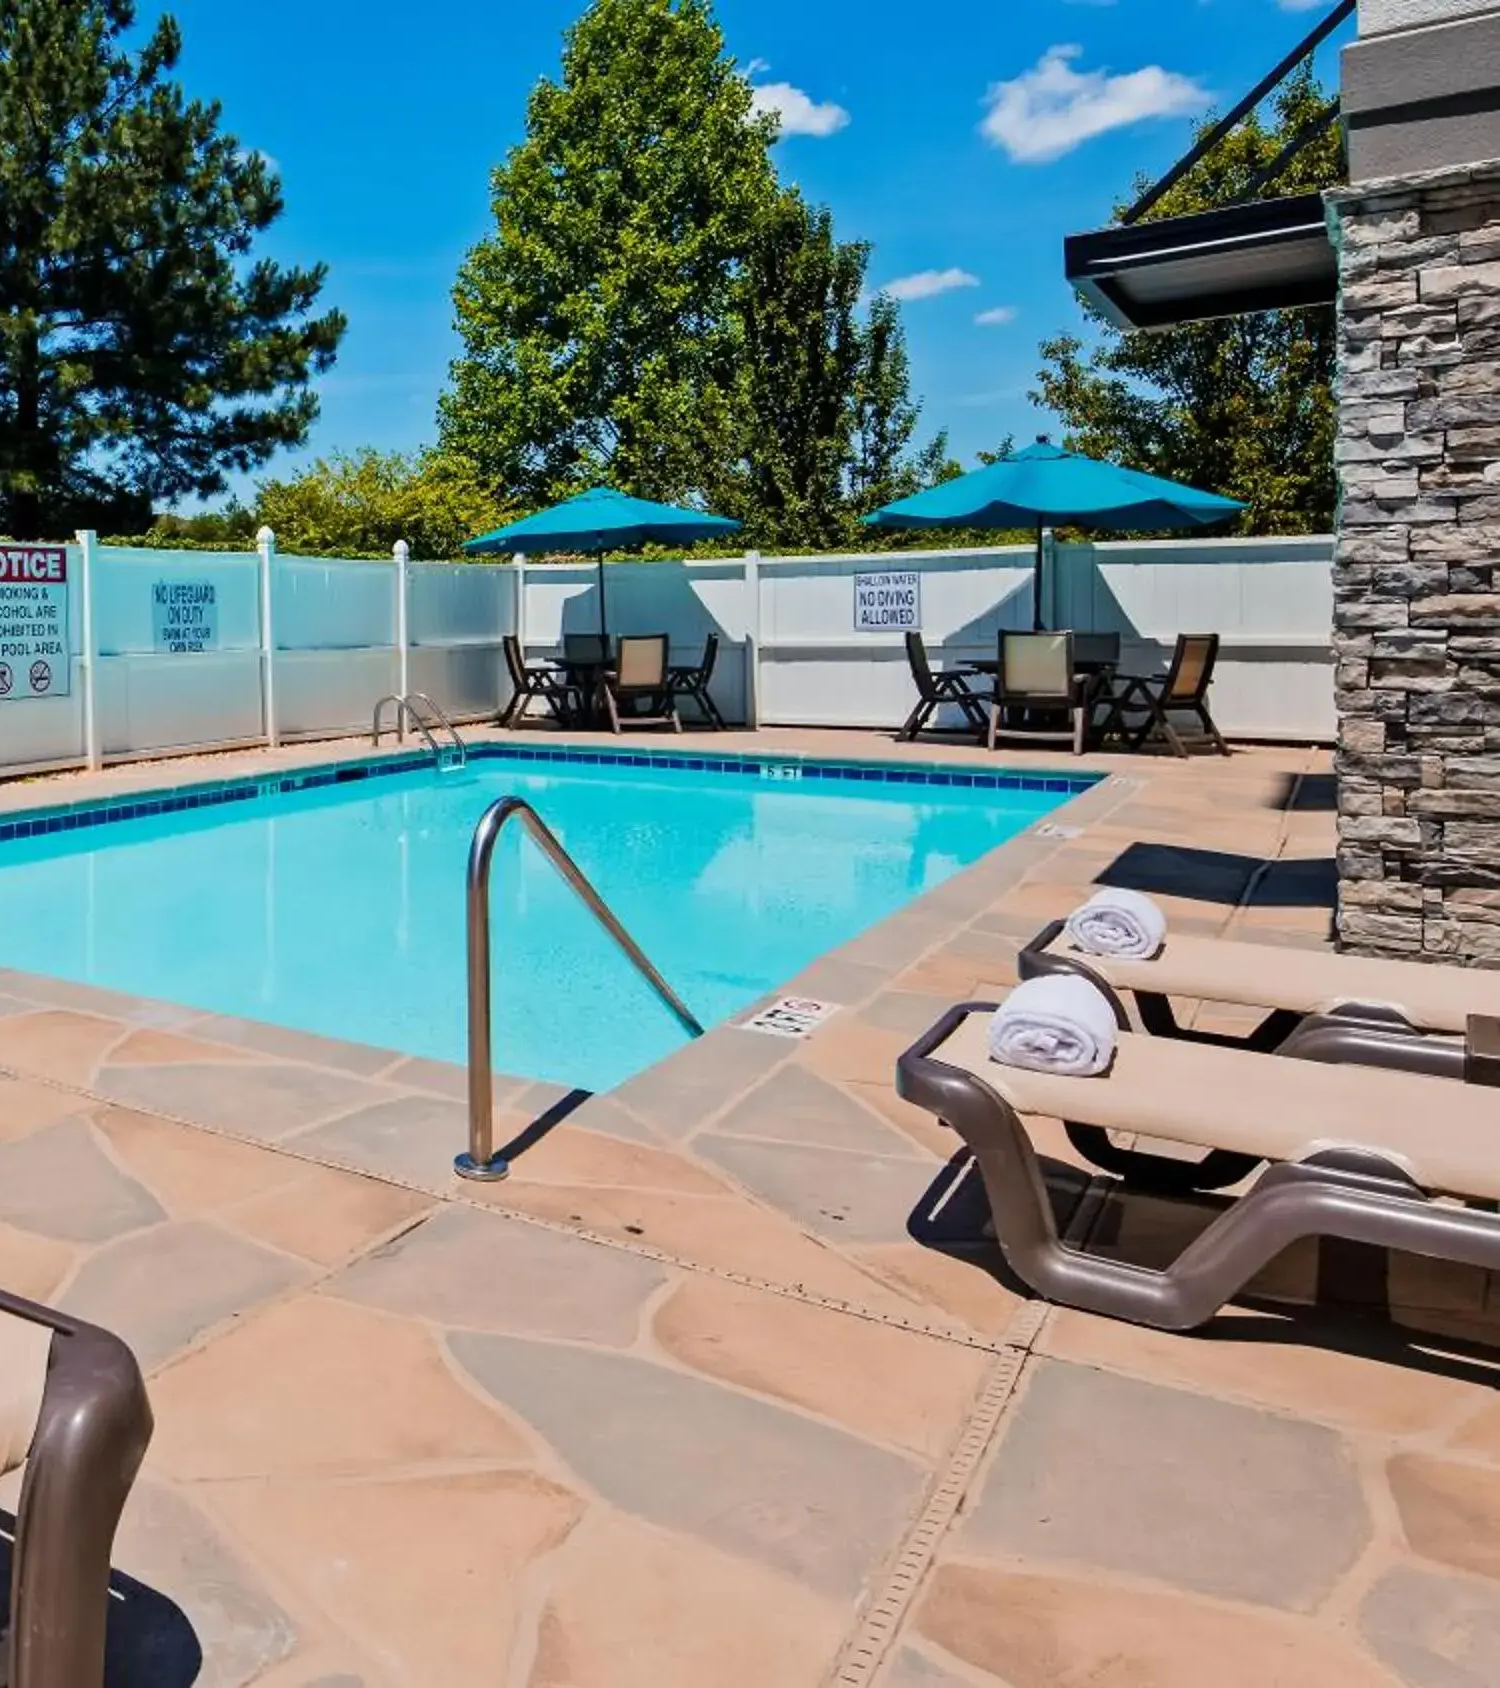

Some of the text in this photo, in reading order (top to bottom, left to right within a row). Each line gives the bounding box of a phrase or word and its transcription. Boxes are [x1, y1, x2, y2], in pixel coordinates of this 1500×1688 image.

[42, 588, 49, 599] &
[860, 590, 915, 606] NO DIVING
[36, 605, 56, 619] ARE
[861, 609, 914, 625] ALLOWED
[48, 624, 58, 636] IN
[1, 644, 31, 656] POOL
[35, 642, 62, 655] AREA
